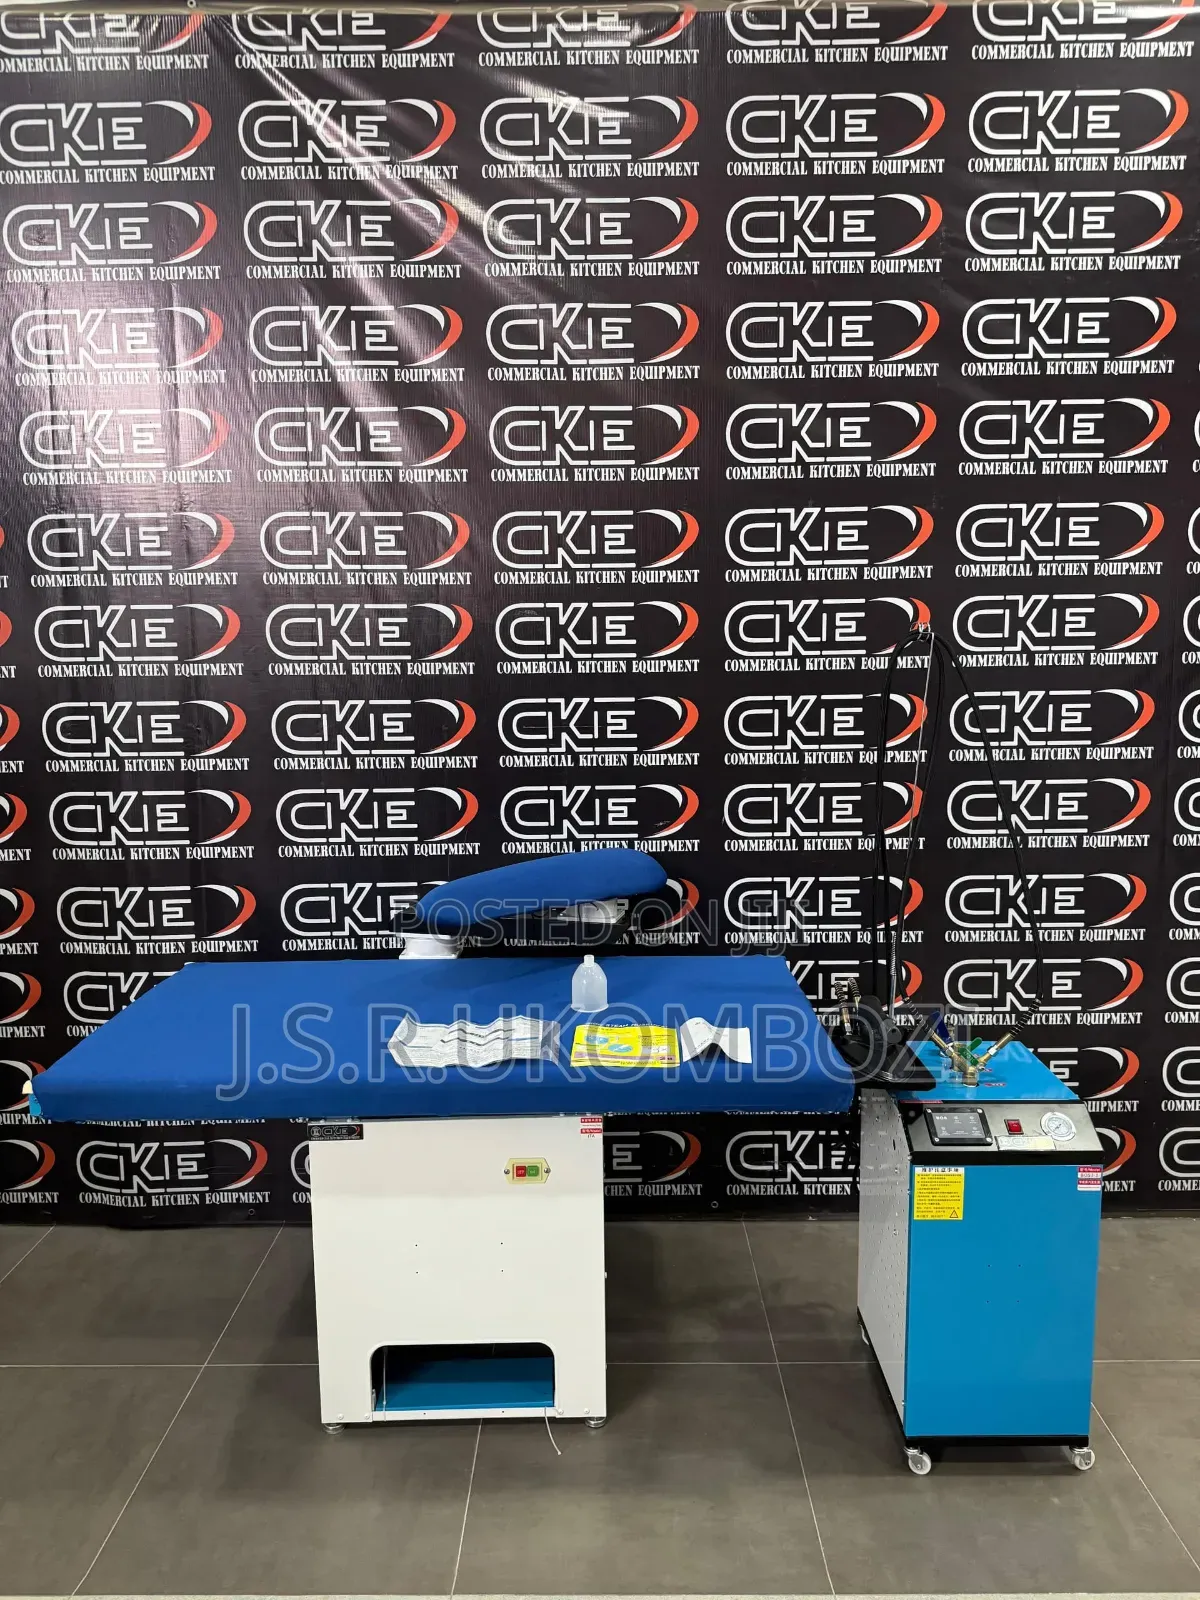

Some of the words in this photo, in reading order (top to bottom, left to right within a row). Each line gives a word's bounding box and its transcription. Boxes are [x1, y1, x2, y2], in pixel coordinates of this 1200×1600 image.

[479, 51, 561, 66] COMMERCIAL
[566, 50, 619, 65] KITCHEN
[626, 50, 699, 65] EQUIPMENT
[727, 48, 809, 64] COMMERCIAL
[815, 47, 867, 63] KITCHEN
[874, 46, 948, 62] EQUIPMENT
[972, 43, 1054, 60] COMMERCIAL
[1060, 42, 1113, 59] KITCHEN
[1120, 42, 1194, 58] EQUIPMENT
[480, 96, 632, 161] CKE
[726, 94, 878, 158] CKE
[969, 90, 1120, 155] CKE
[482, 163, 563, 179] COMMERCIAL
[568, 162, 620, 178] KITCHEN
[627, 162, 699, 177] EQUIPMENT
[727, 160, 808, 176] COMMERCIAL
[813, 159, 866, 175] KITCHEN
[872, 159, 945, 174] EQUIPMENT
[968, 156, 1049, 171] COMMERCIAL
[1054, 156, 1106, 171] KITCHEN
[1114, 156, 1186, 171] EQUIPMENT
[244, 200, 395, 262] CKE
[483, 198, 633, 260] CKE
[726, 195, 876, 258] CKE
[966, 191, 1115, 254] CKE
[3, 202, 153, 265] CKE
[247, 264, 326, 278] COMMERCIAL
[332, 264, 383, 278] KITCHEN
[390, 264, 461, 278] EQUIPMENT
[485, 262, 565, 277] COMMERCIAL
[570, 261, 621, 277] KITCHEN
[628, 261, 699, 276] EQUIPMENT
[727, 260, 806, 274] COMMERCIAL
[812, 260, 864, 274] KITCHEN
[870, 259, 941, 274] EQUIPMENT
[965, 256, 1045, 272] COMMERCIAL
[1050, 256, 1102, 271] KITCHEN
[1108, 255, 1180, 270] EQUIPMENT
[6, 267, 83, 282] COMMERCIAL
[91, 266, 143, 282] KITCHEN
[149, 266, 220, 281] EQUIPMENT
[486, 303, 634, 364] CKE
[726, 301, 874, 363] CKE
[963, 297, 1110, 359] CKE
[488, 366, 566, 381] COMMERCIAL
[572, 366, 622, 381] KITCHEN
[630, 365, 700, 380] EQUIPMENT
[727, 365, 805, 379] COMMERCIAL
[811, 364, 862, 379] KITCHEN
[868, 364, 938, 378] EQUIPMENT
[962, 361, 1041, 376] COMMERCIAL
[1046, 361, 1096, 375] KITCHEN
[1104, 360, 1174, 374] EQUIPMENT
[254, 406, 403, 466] CKE
[726, 402, 871, 463] CKE
[959, 399, 1104, 459] CKE
[257, 468, 336, 482] COMMERCIAL
[341, 468, 394, 482] KITCHEN
[398, 468, 467, 482] EQUIPMENT
[726, 464, 804, 480] COMMERCIAL
[810, 464, 860, 479] KITCHEN
[866, 463, 936, 479] EQUIPMENT
[959, 461, 1036, 474] COMMERCIAL
[1042, 461, 1092, 474] KITCHEN
[1098, 460, 1168, 474] EQUIPMENT
[260, 511, 407, 569] CKE
[725, 507, 869, 566] CKE
[956, 503, 1100, 561] CKE
[27, 511, 172, 571] CKE
[726, 567, 802, 582] COMMERCIAL
[807, 566, 857, 581] KITCHEN
[863, 565, 933, 580] EQUIPMENT
[955, 563, 1032, 576] COMMERCIAL
[1037, 563, 1087, 576] KITCHEN
[1093, 562, 1163, 575] EQUIPMENT
[30, 573, 108, 588] COMMERCIAL
[112, 572, 162, 587] KITCHEN
[168, 572, 238, 586] EQUIPMENT
[263, 572, 341, 586] COMMERCIAL
[346, 572, 397, 585] KITCHEN
[403, 572, 471, 585] EQUIPMENT
[495, 602, 636, 659] CKE
[953, 594, 1096, 651] CKE
[35, 605, 178, 662] CKE
[266, 604, 411, 660] CKE
[497, 661, 572, 674] COMMERCIAL
[577, 660, 626, 674] KITCHEN
[632, 659, 700, 673] EQUIPMENT
[952, 653, 1029, 667] OMMERCIAL
[1034, 652, 1084, 667] KITCHEN
[1090, 652, 1158, 666] EQUIPMENT
[38, 664, 114, 677] COMMERCIAL
[118, 663, 168, 677] KITCHEN
[174, 663, 243, 676] EQUIPMENT
[269, 662, 346, 675] COMMERCIAL
[351, 662, 400, 675] KITCHEN
[407, 662, 475, 675] EQUIPMENT
[42, 701, 184, 757] CKE
[272, 700, 415, 755] CKE
[498, 697, 637, 752] CKE
[724, 694, 864, 749] CKE
[46, 759, 121, 772] COMMERCIAL
[124, 759, 174, 771] KITCHEN
[180, 759, 249, 771] EQUIPMENT
[274, 756, 350, 770] COMMERCIAL
[355, 756, 404, 769] KITCHEN
[410, 756, 477, 769] EQUIPMENT
[500, 755, 574, 768] COMMERCIAL
[579, 754, 627, 767] KITCHEN
[633, 753, 700, 766] EQUIPMENT
[725, 751, 799, 764] COMMERCIAL
[804, 751, 853, 764] KITCHEN
[276, 788, 418, 842] CKE
[947, 779, 1088, 834] CKE
[49, 791, 190, 845] CKE
[279, 843, 354, 857] COMMERCIAL
[359, 843, 408, 856] KITCHEN
[414, 843, 480, 856] EQUIPMENT
[1028, 835, 1076, 848] KITCHEN
[1082, 835, 1150, 847] EQUIPMENT
[52, 848, 127, 860] COMMERCIAL
[130, 847, 180, 860] KITCHEN
[186, 847, 254, 859] EQUIPMENT
[945, 874, 1085, 928] CKE
[57, 886, 195, 940] CKE
[725, 931, 798, 944] COMMERCIAL
[803, 931, 851, 943] KITCHEN
[945, 930, 1020, 942] COMMERCIAL
[1025, 929, 1073, 942] KTCHEN
[1079, 929, 1146, 941] EQUIPMENT
[60, 942, 134, 956] COMMERCIAL
[135, 941, 185, 955] KITCHEN
[191, 941, 258, 954] EQUIPMENT
[1077, 1013, 1142, 1025] EQUIPMENT
[76, 1140, 209, 1193] CKE
[638, 1183, 703, 1197] EQUIPMENT
[726, 1184, 798, 1196] COMMERCIAL
[804, 1183, 851, 1196] KITCHEN
[79, 1192, 146, 1207] COMMERCIAL
[151, 1194, 200, 1206] KITCHEN
[205, 1191, 270, 1204] EQUIPMENT
